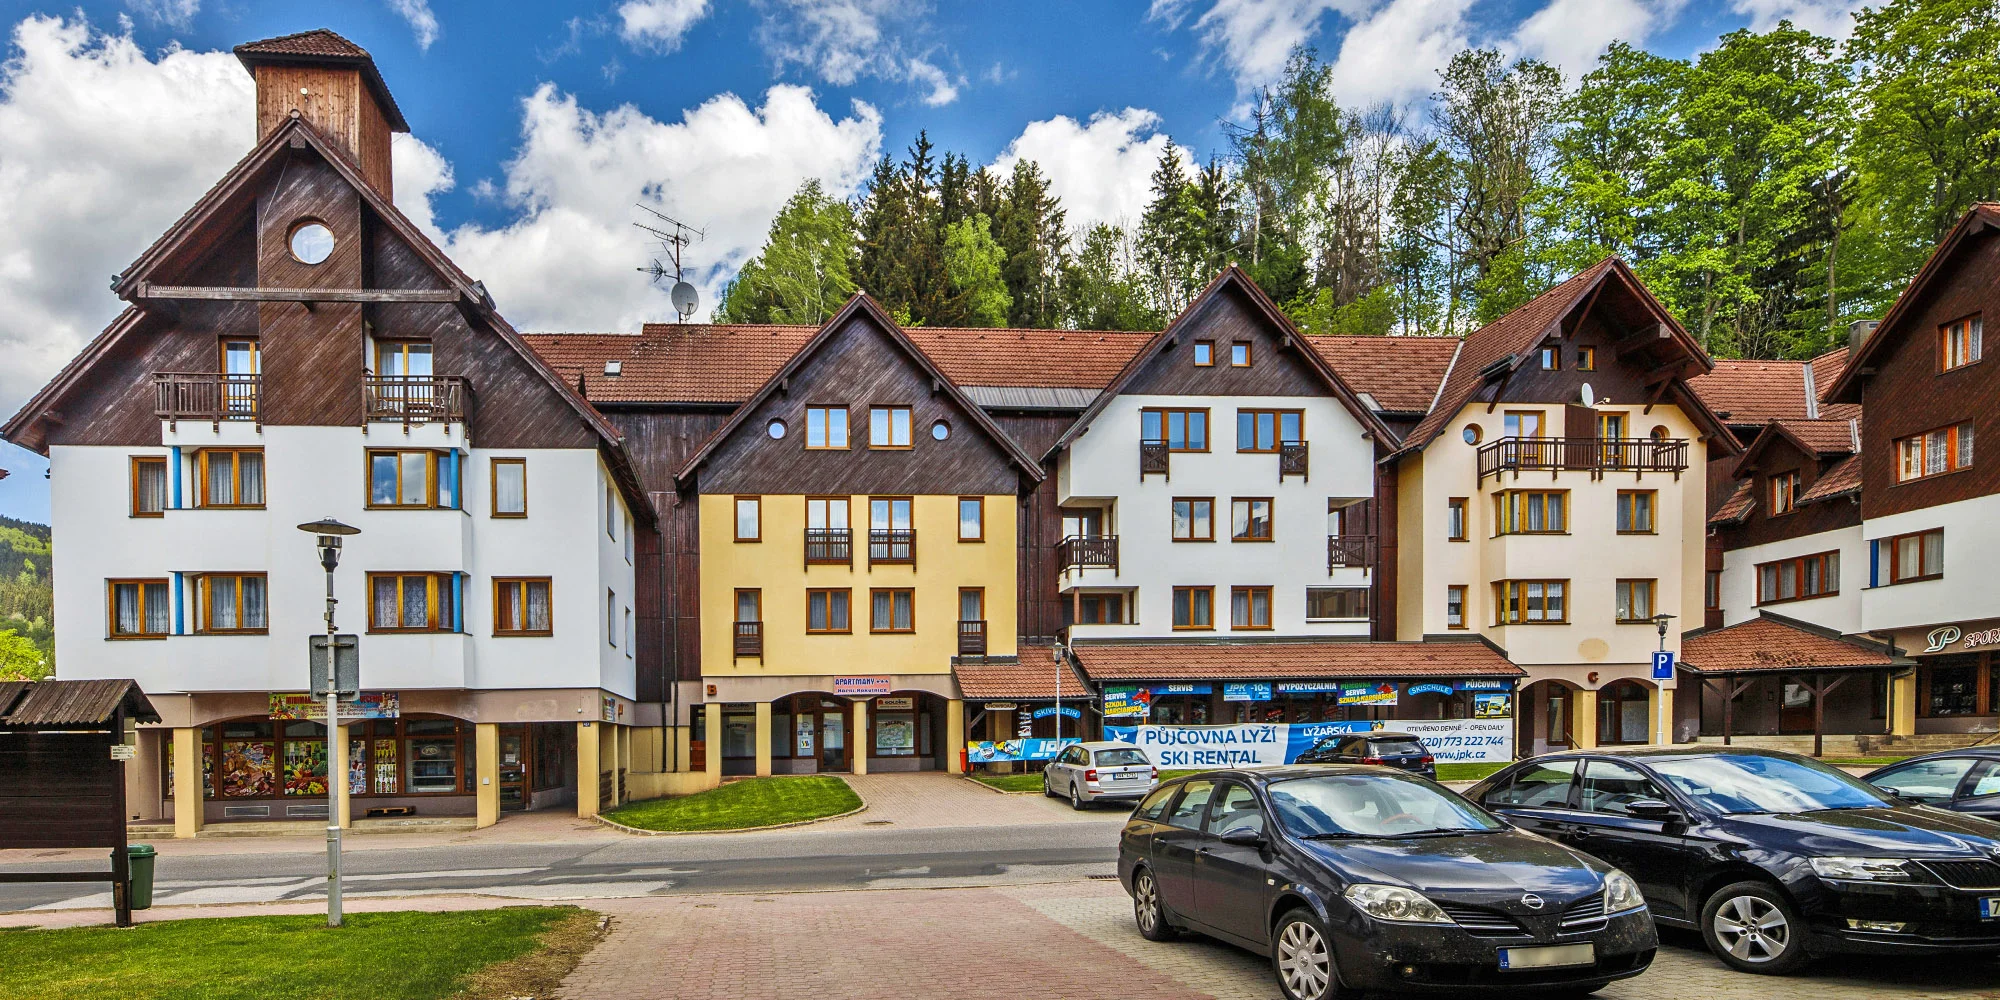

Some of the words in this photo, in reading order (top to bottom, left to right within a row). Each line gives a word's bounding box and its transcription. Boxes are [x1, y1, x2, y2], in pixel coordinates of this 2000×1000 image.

[1964, 628, 2000, 648] SPOR
[1658, 654, 1668, 670] P
[707, 684, 718, 696] B
[1411, 684, 1450, 694] SKISCHULE
[1036, 707, 1078, 717] SKIVELEIH
[1303, 724, 1353, 737] LYŽAŘSKÁ
[1440, 724, 1462, 732] DENNĚ
[1146, 726, 1237, 746] PŮJČOVNA
[1241, 725, 1277, 744] LYŽÍ
[1444, 737, 1463, 747] 773
[1464, 736, 1484, 746] 222
[1485, 735, 1504, 746] 744
[1160, 750, 1188, 766] SKI
[1193, 749, 1261, 765] RENTAL
